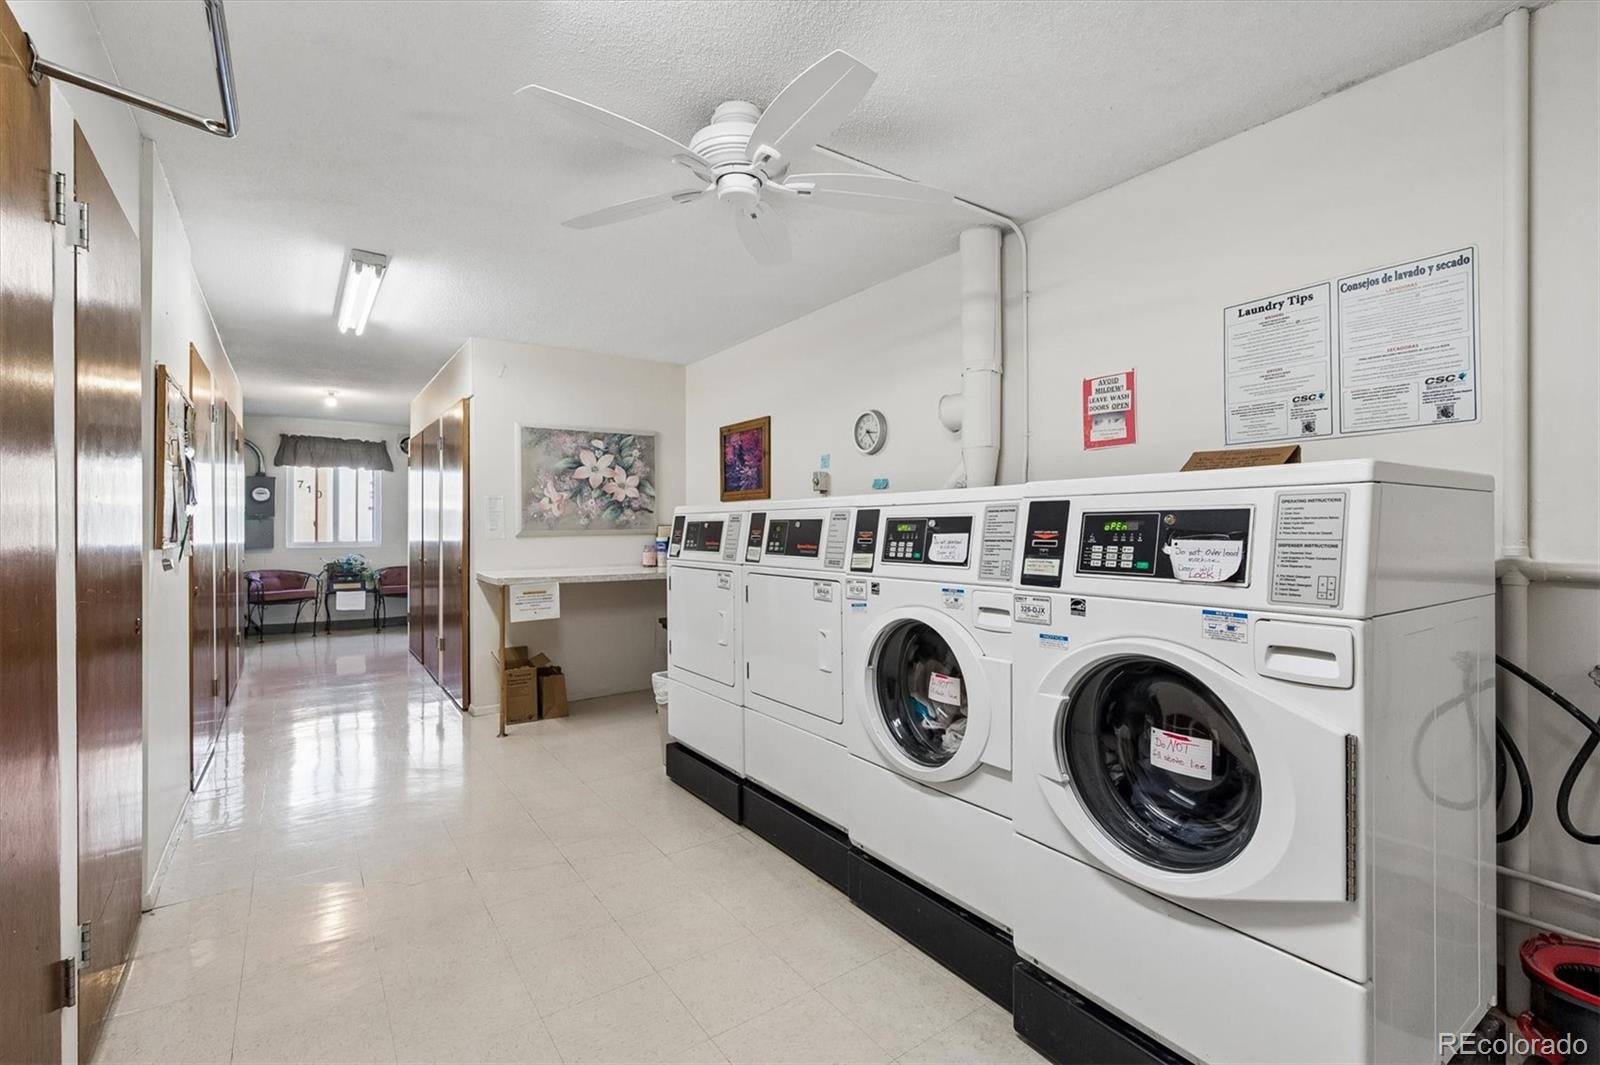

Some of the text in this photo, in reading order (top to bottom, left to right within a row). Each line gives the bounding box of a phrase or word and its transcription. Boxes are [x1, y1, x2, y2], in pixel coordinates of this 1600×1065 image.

[1340, 255, 1469, 293] Consejos de lavado y secado
[1237, 293, 1313, 318] Laundry Tips
[1098, 377, 1119, 386] AVOID
[1425, 374, 1455, 385] CSC
[1089, 393, 1129, 404] LEAVE WASH
[1292, 394, 1316, 403] CSC
[1089, 402, 1129, 412] DOORS OPEN
[1155, 737, 1199, 754] Do NOT
